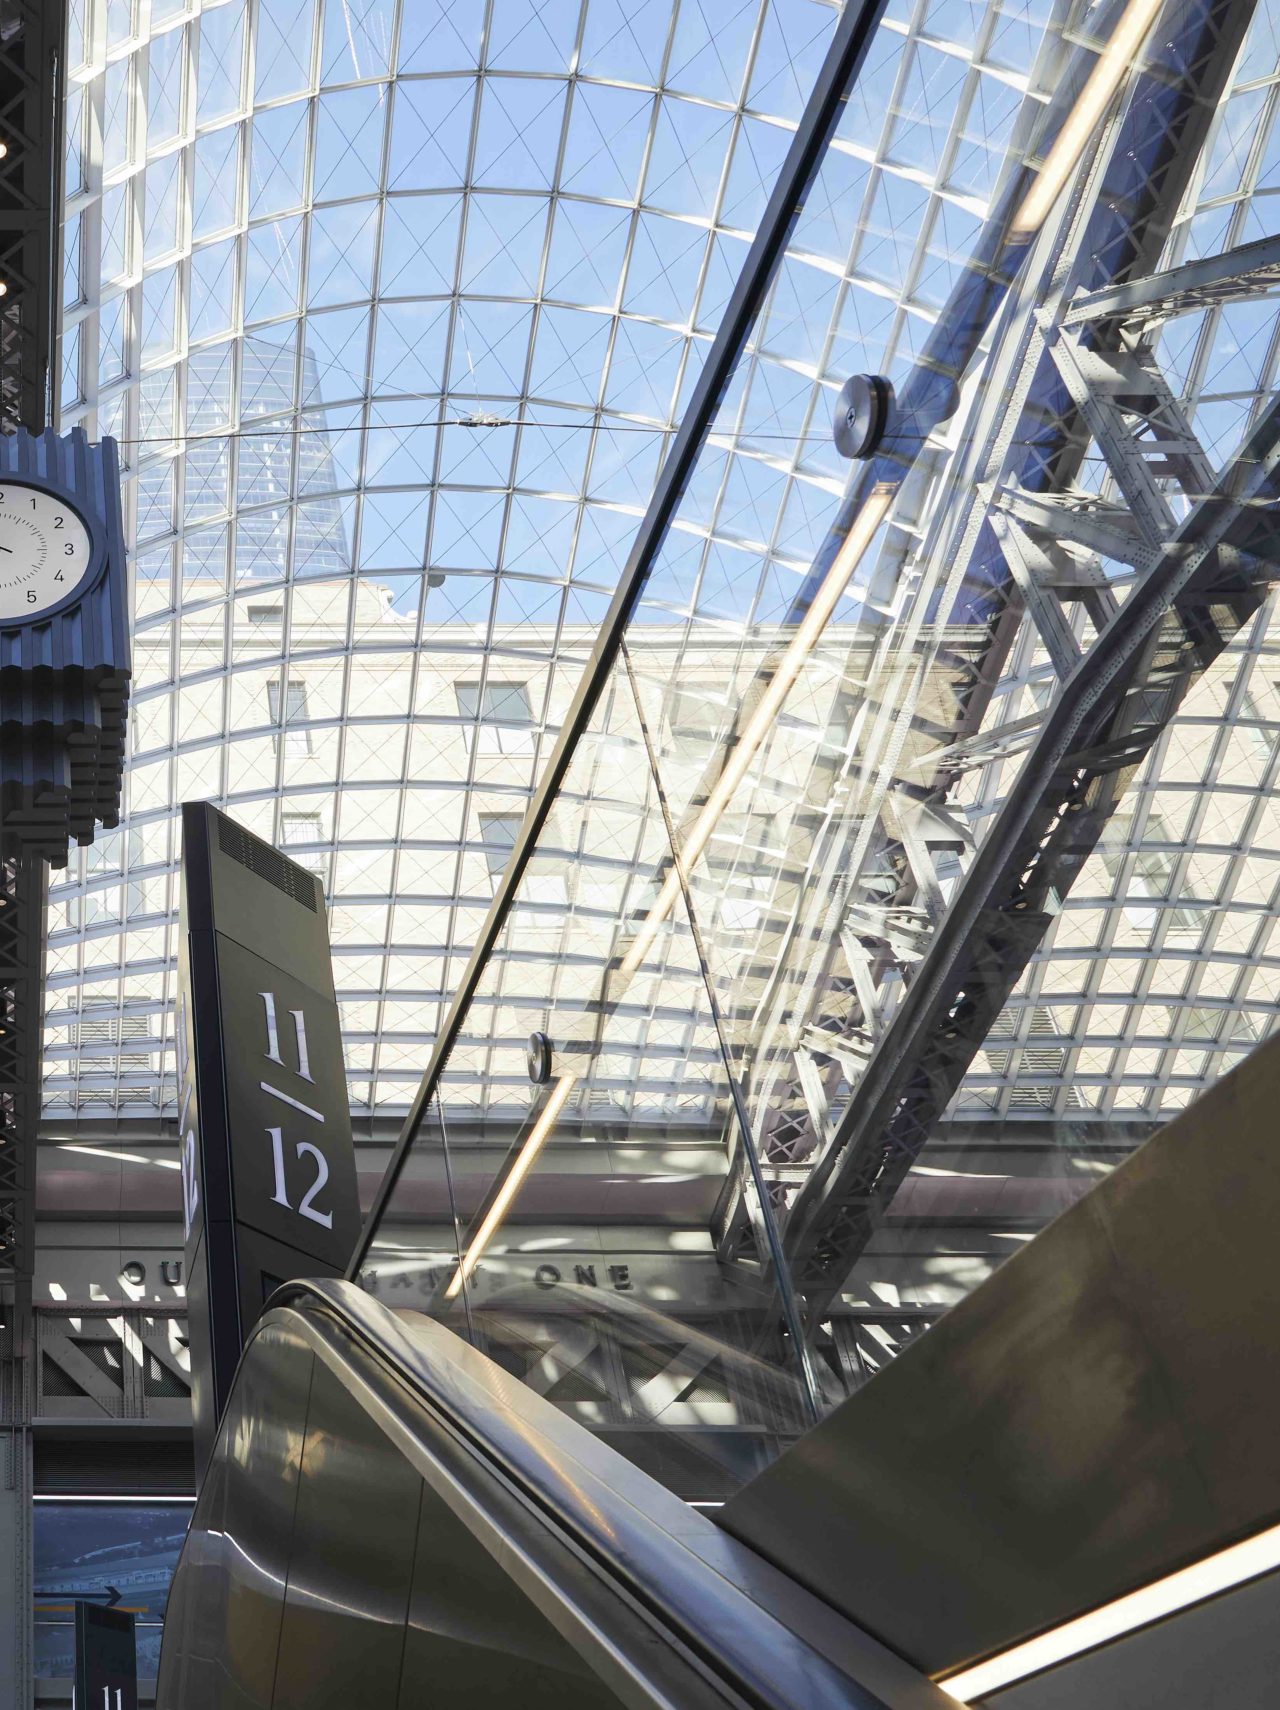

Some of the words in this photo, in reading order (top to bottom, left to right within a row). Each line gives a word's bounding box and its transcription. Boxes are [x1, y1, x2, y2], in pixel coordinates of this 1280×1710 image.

[53, 516, 65, 530] 2
[64, 543, 75, 556] 3
[53, 569, 65, 582] 4
[26, 590, 37, 603] 5
[256, 991, 317, 1085] 11
[265, 1126, 334, 1231] 12
[533, 1263, 634, 1291] ONE
